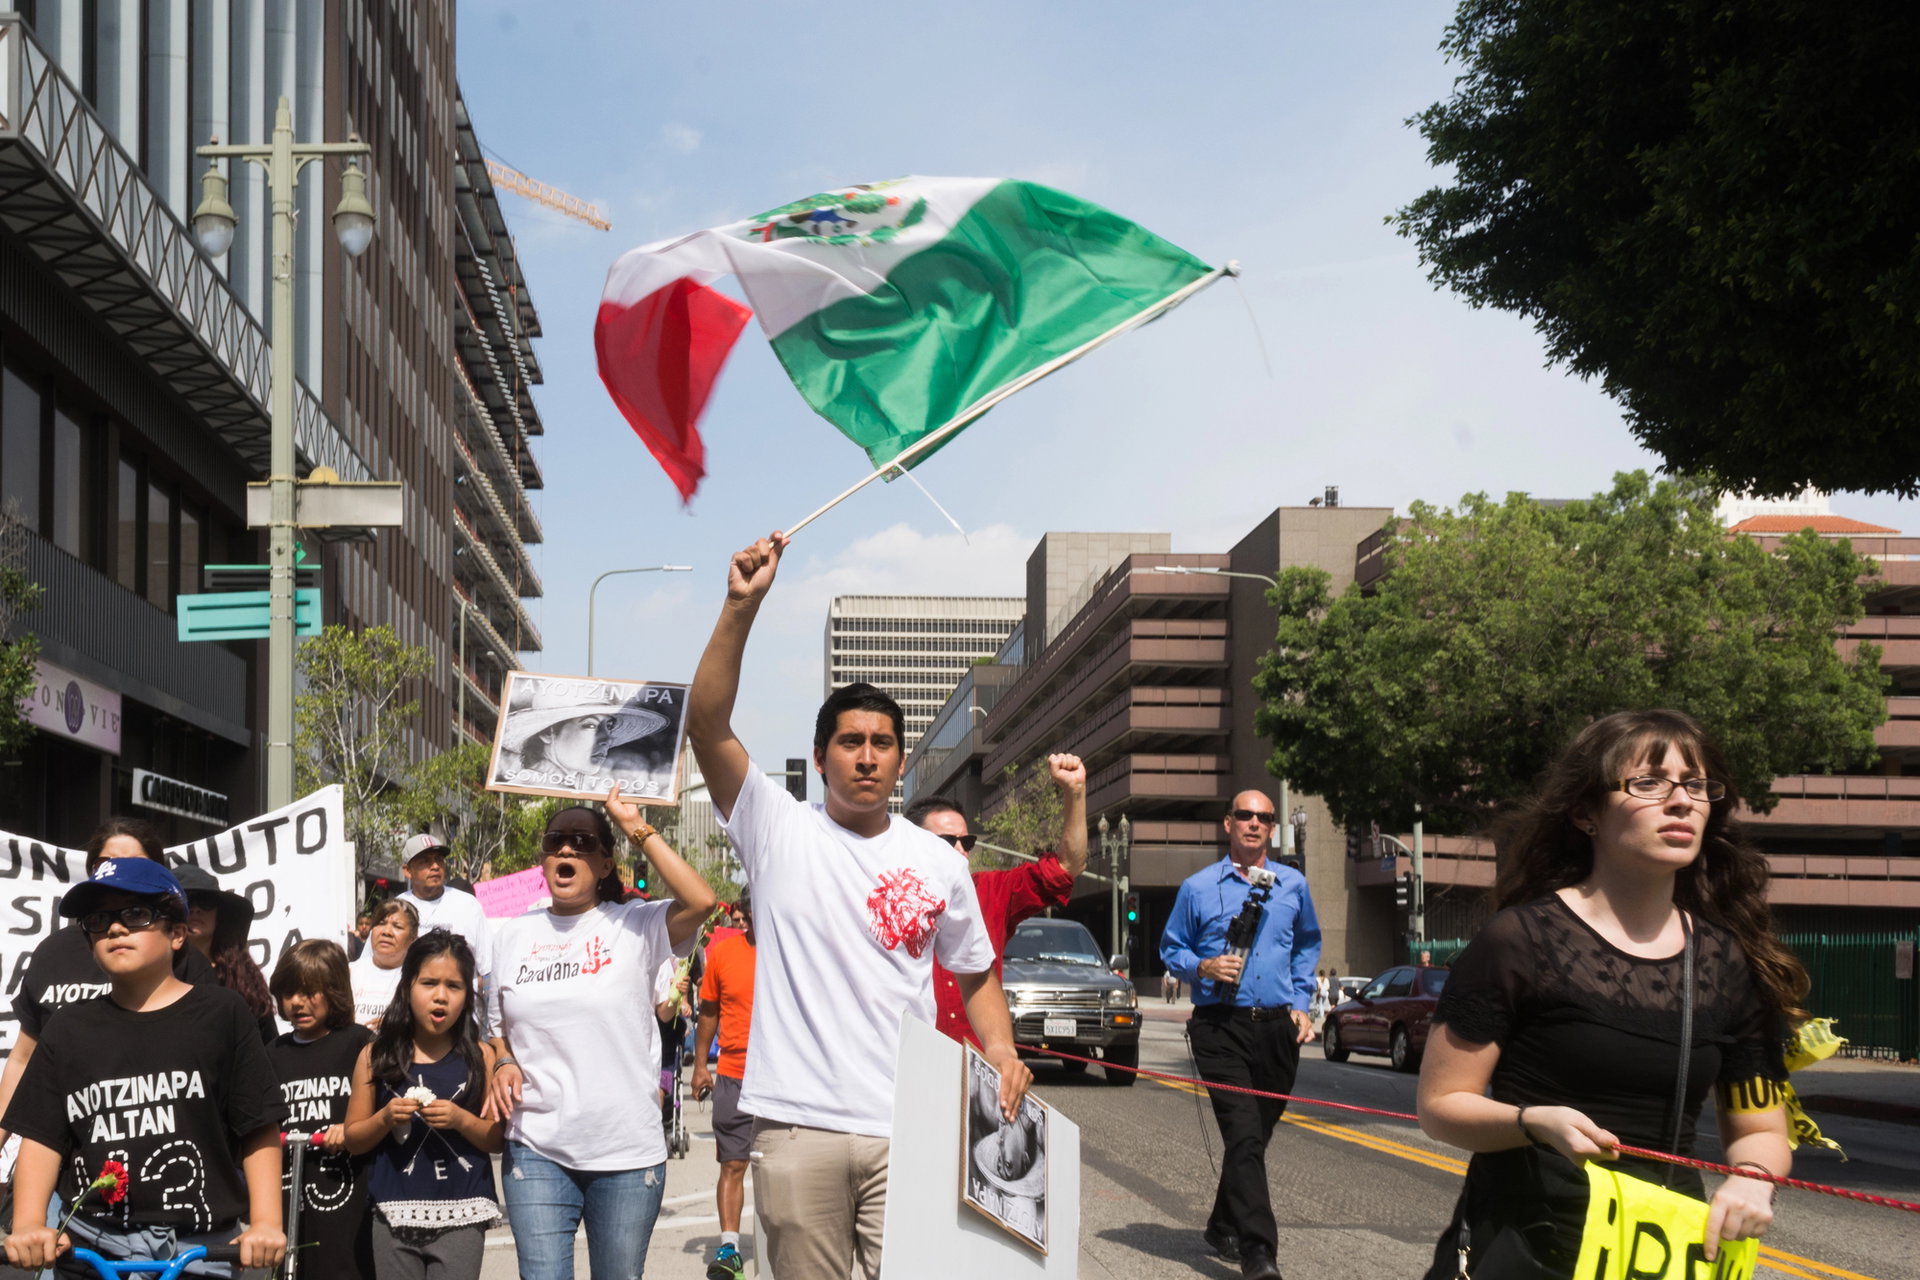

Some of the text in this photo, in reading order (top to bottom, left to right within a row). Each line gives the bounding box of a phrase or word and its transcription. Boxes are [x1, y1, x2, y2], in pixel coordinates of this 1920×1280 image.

[520, 678, 674, 705] AYOTZINAPA
[503, 769, 660, 793] SOMOS TODOS
[516, 962, 581, 986] Caravana
[66, 1070, 206, 1123] AYOTZINAPA
